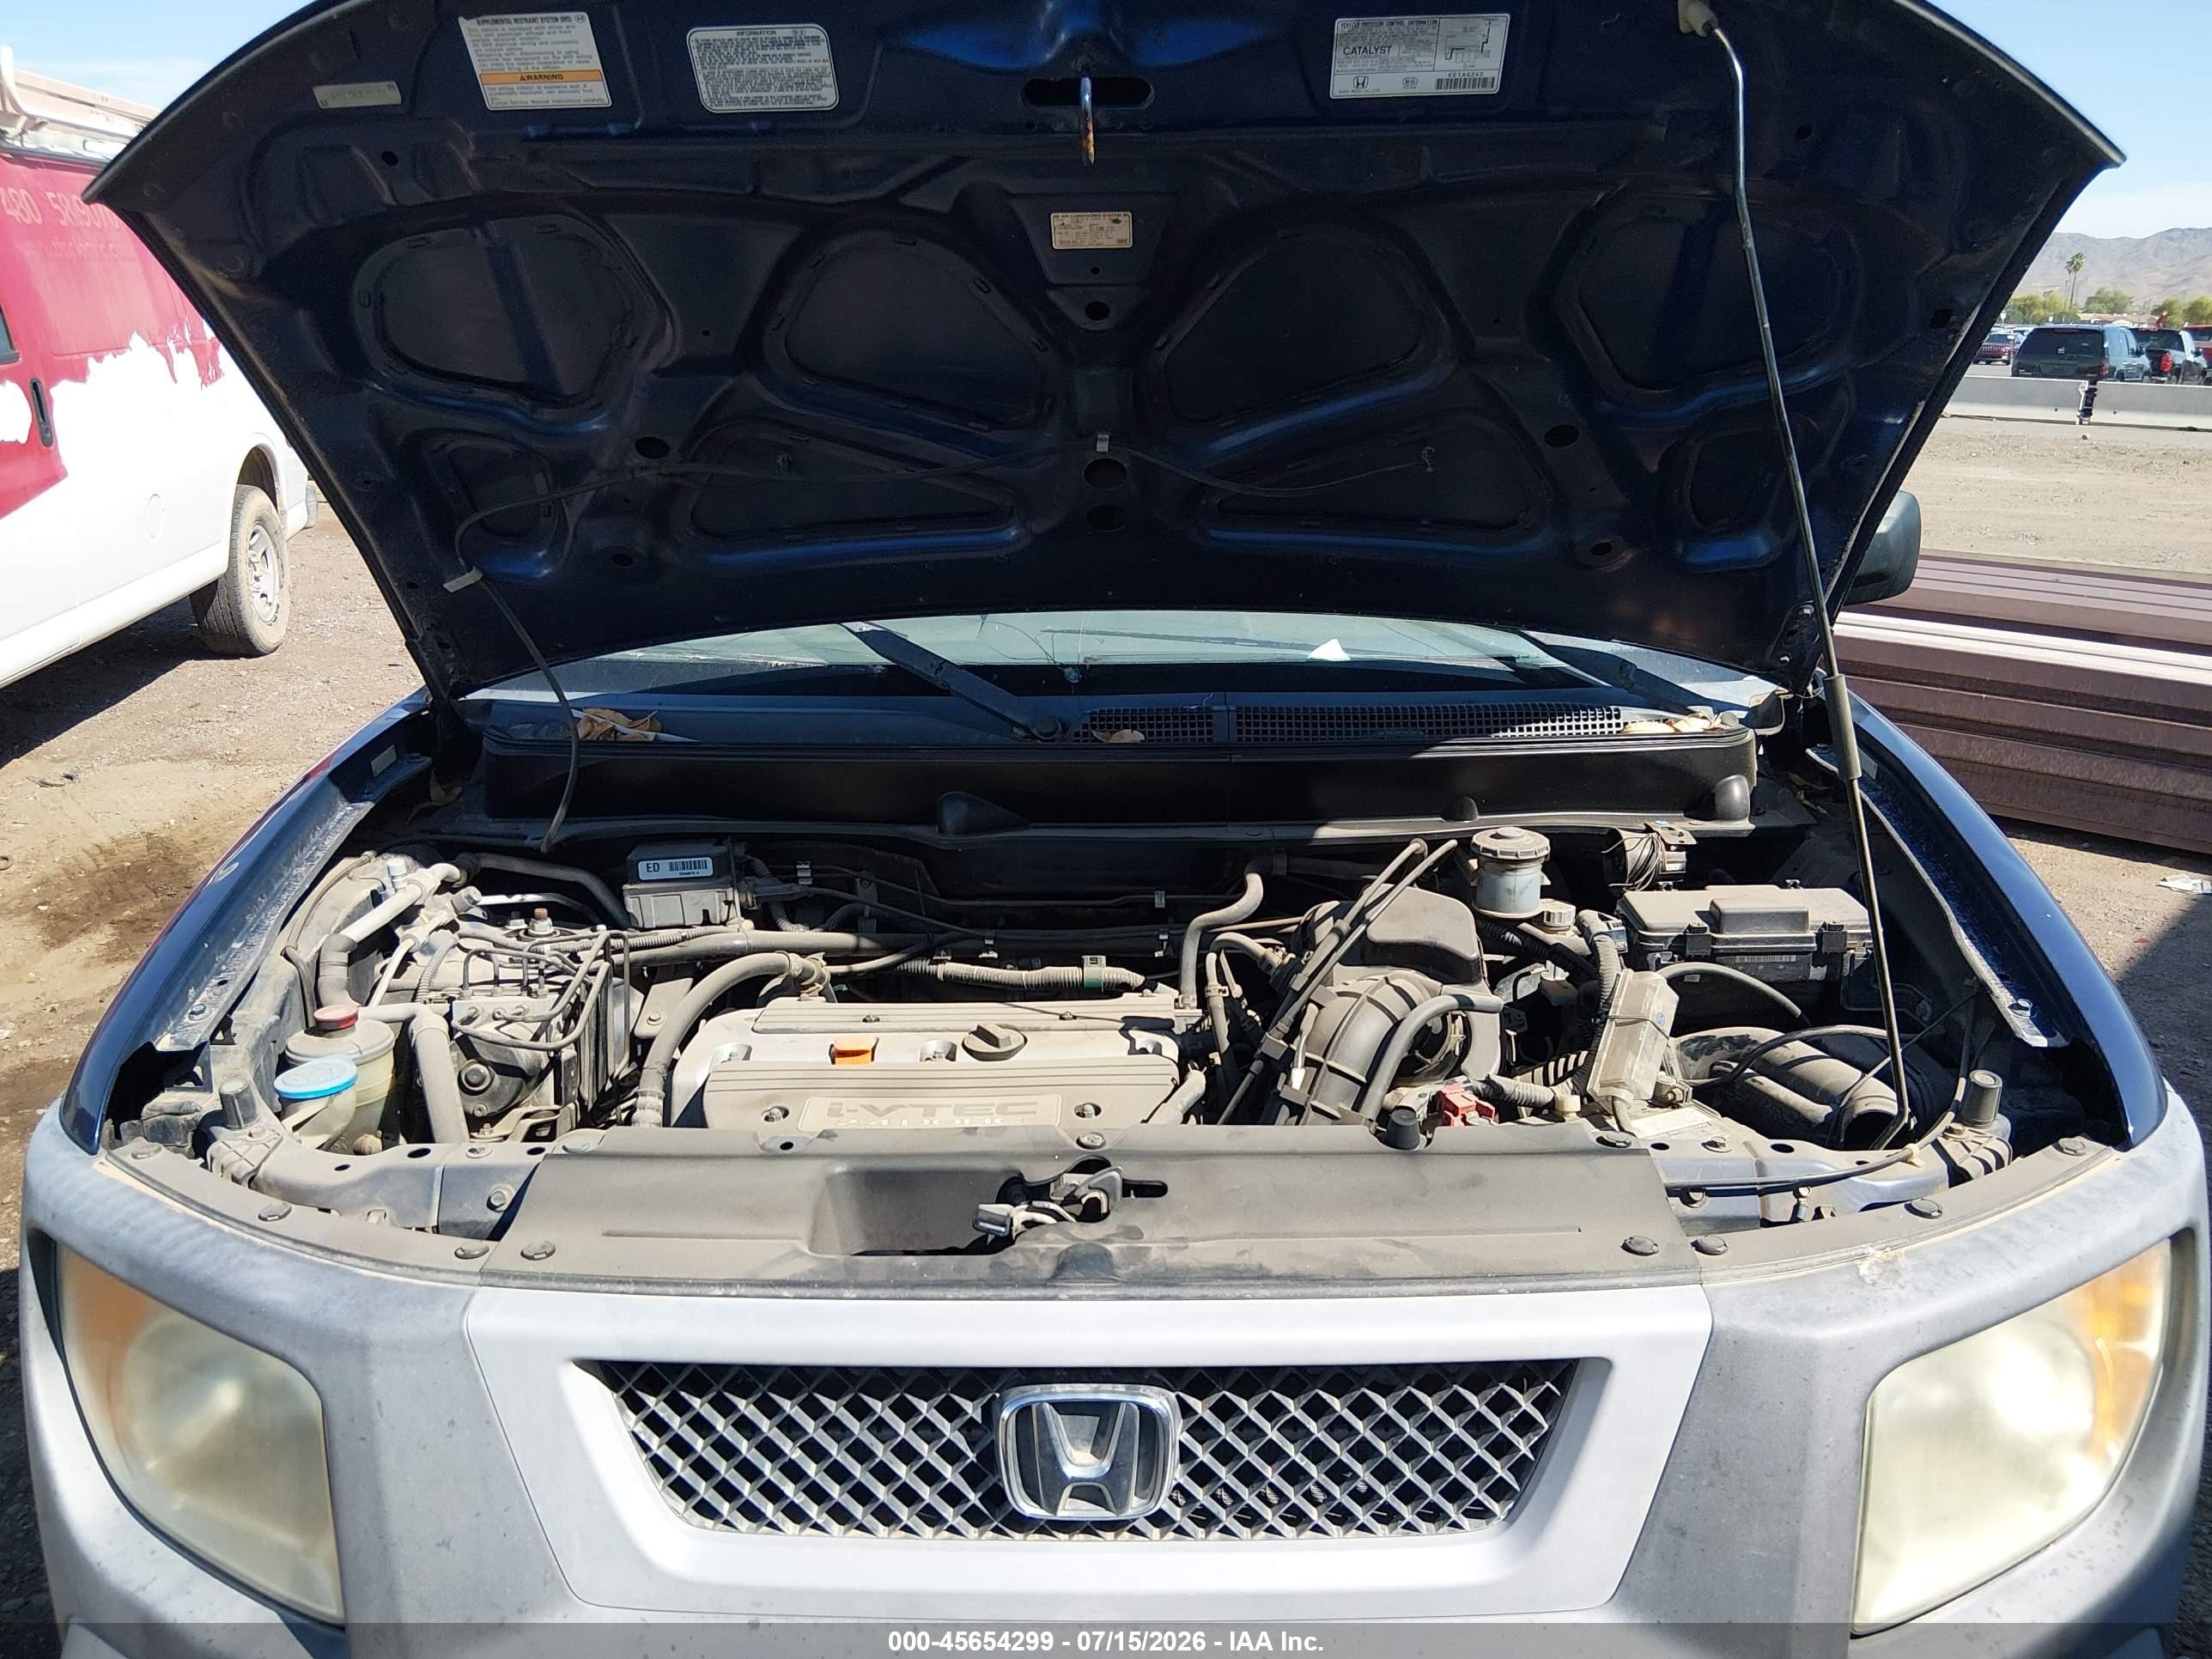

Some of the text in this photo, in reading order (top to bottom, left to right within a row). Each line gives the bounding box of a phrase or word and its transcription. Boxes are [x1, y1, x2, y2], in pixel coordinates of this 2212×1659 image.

[1342, 46, 1392, 56] CATALYST
[526, 73, 564, 82] WARNING
[0, 185, 42, 226] 480
[646, 862, 660, 873] ED
[826, 1101, 1038, 1118] i-VTEC
